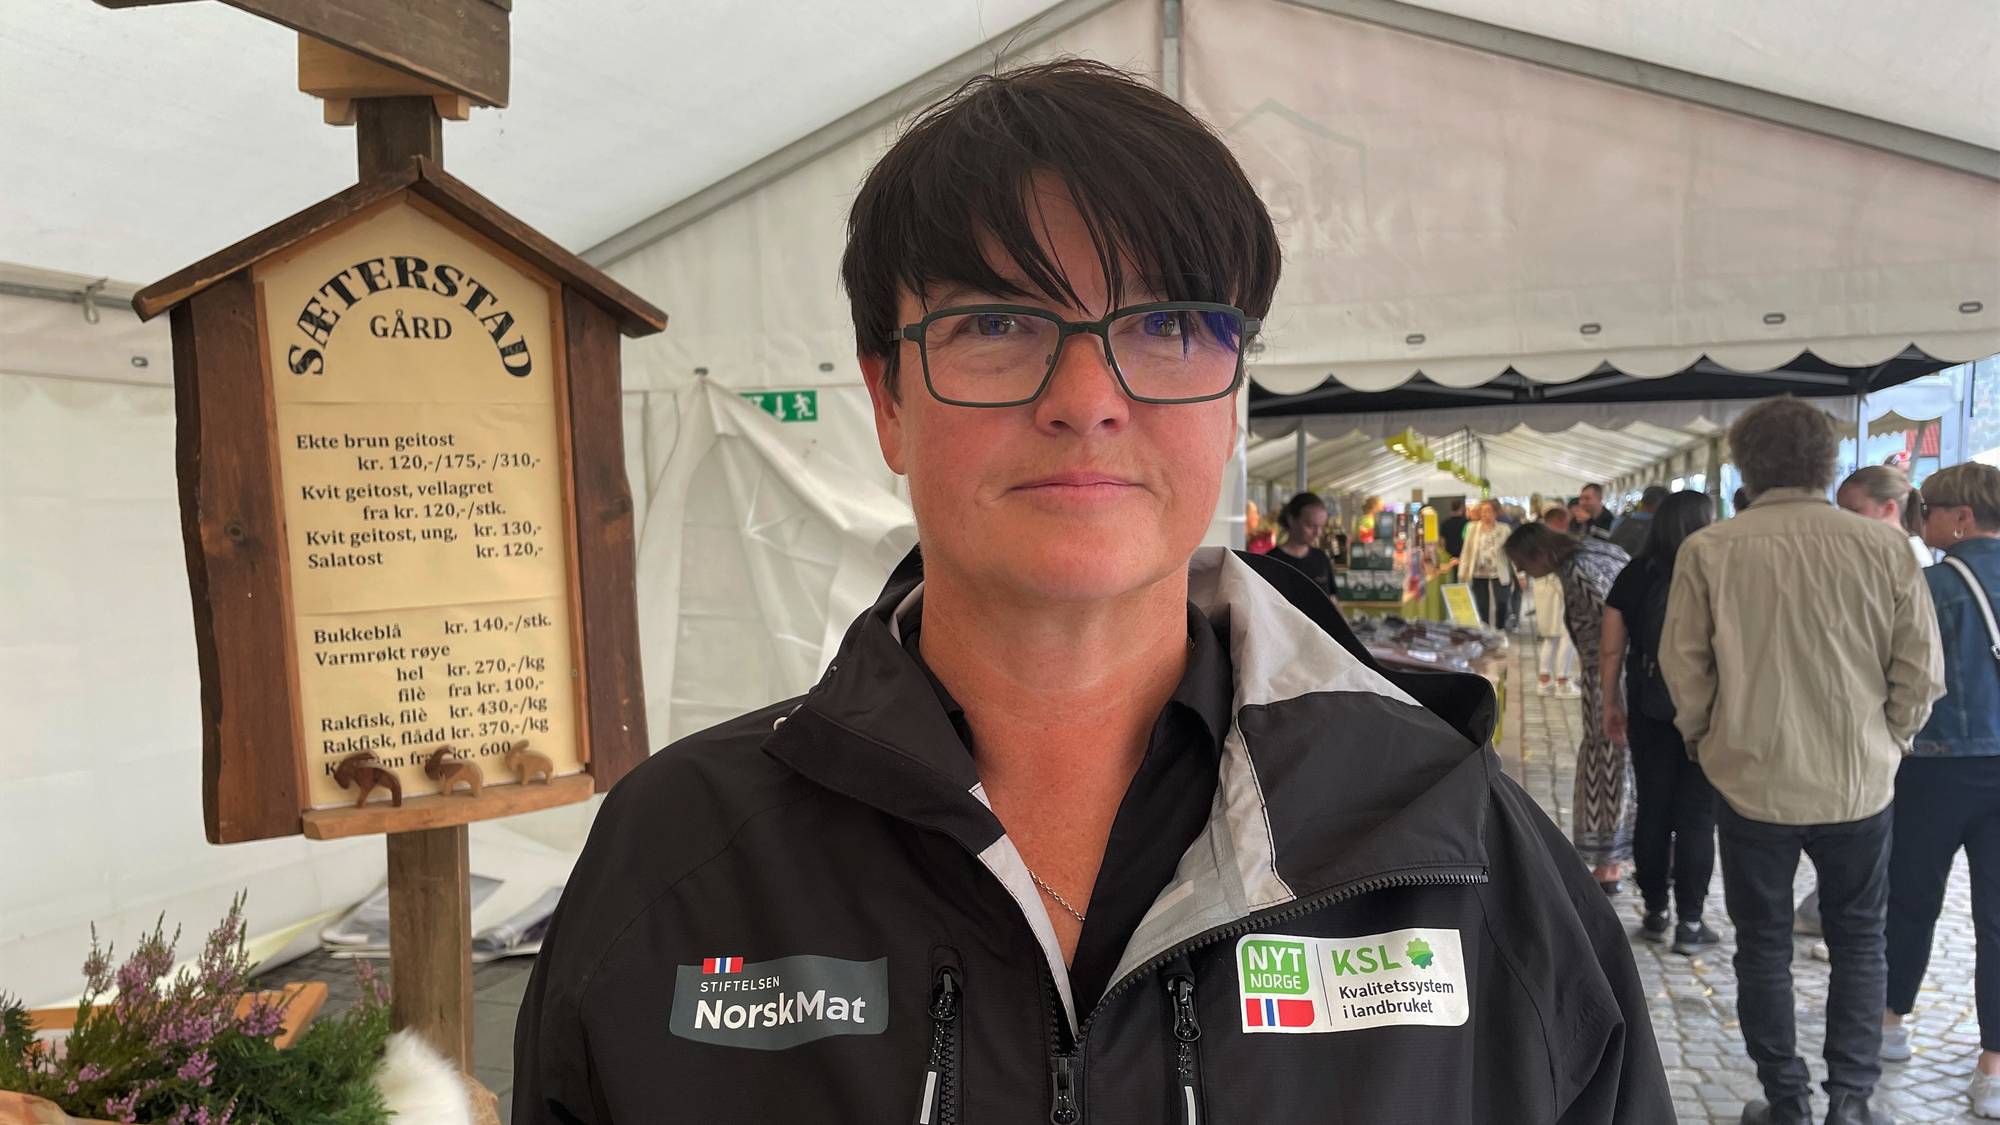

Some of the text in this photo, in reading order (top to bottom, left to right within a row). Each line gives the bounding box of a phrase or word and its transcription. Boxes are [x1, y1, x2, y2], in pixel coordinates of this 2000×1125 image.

[288, 256, 532, 378] SÆTERSTAD
[370, 309, 452, 340] GÅRD
[296, 431, 455, 450] Ekte brun geitost
[357, 456, 384, 470] kr.
[301, 480, 494, 502] Kvit geitost, vellagret
[363, 501, 507, 520] fra kr. 120,-/stk.
[306, 520, 542, 548] Kvit geitost, ung, kr. 130,-
[308, 542, 544, 568] Salatost kr. 120,-
[314, 613, 552, 644] Bukkeblå kr. 140,-/stk.
[315, 645, 450, 666] Varmrøkt røye
[397, 655, 545, 682] hel kr. 270,-/kg
[448, 683, 472, 698] fra
[477, 680, 499, 695] kr.
[505, 677, 544, 693] 100,-
[321, 712, 395, 733] Rakfisk,
[450, 704, 473, 719] kr.
[477, 696, 548, 716] 430,-/kg
[323, 716, 549, 754] Rakfisk, flådd kr. 370,-/kg
[1249, 946, 1302, 972] NYT
[1331, 944, 1403, 977] KSL
[700, 975, 780, 993] STIFTELSEN
[1250, 973, 1302, 990] NORGE
[1339, 979, 1454, 999] Kvalitetssystem
[694, 990, 866, 1030] NorskMat
[1343, 998, 1433, 1019] i landbruket
